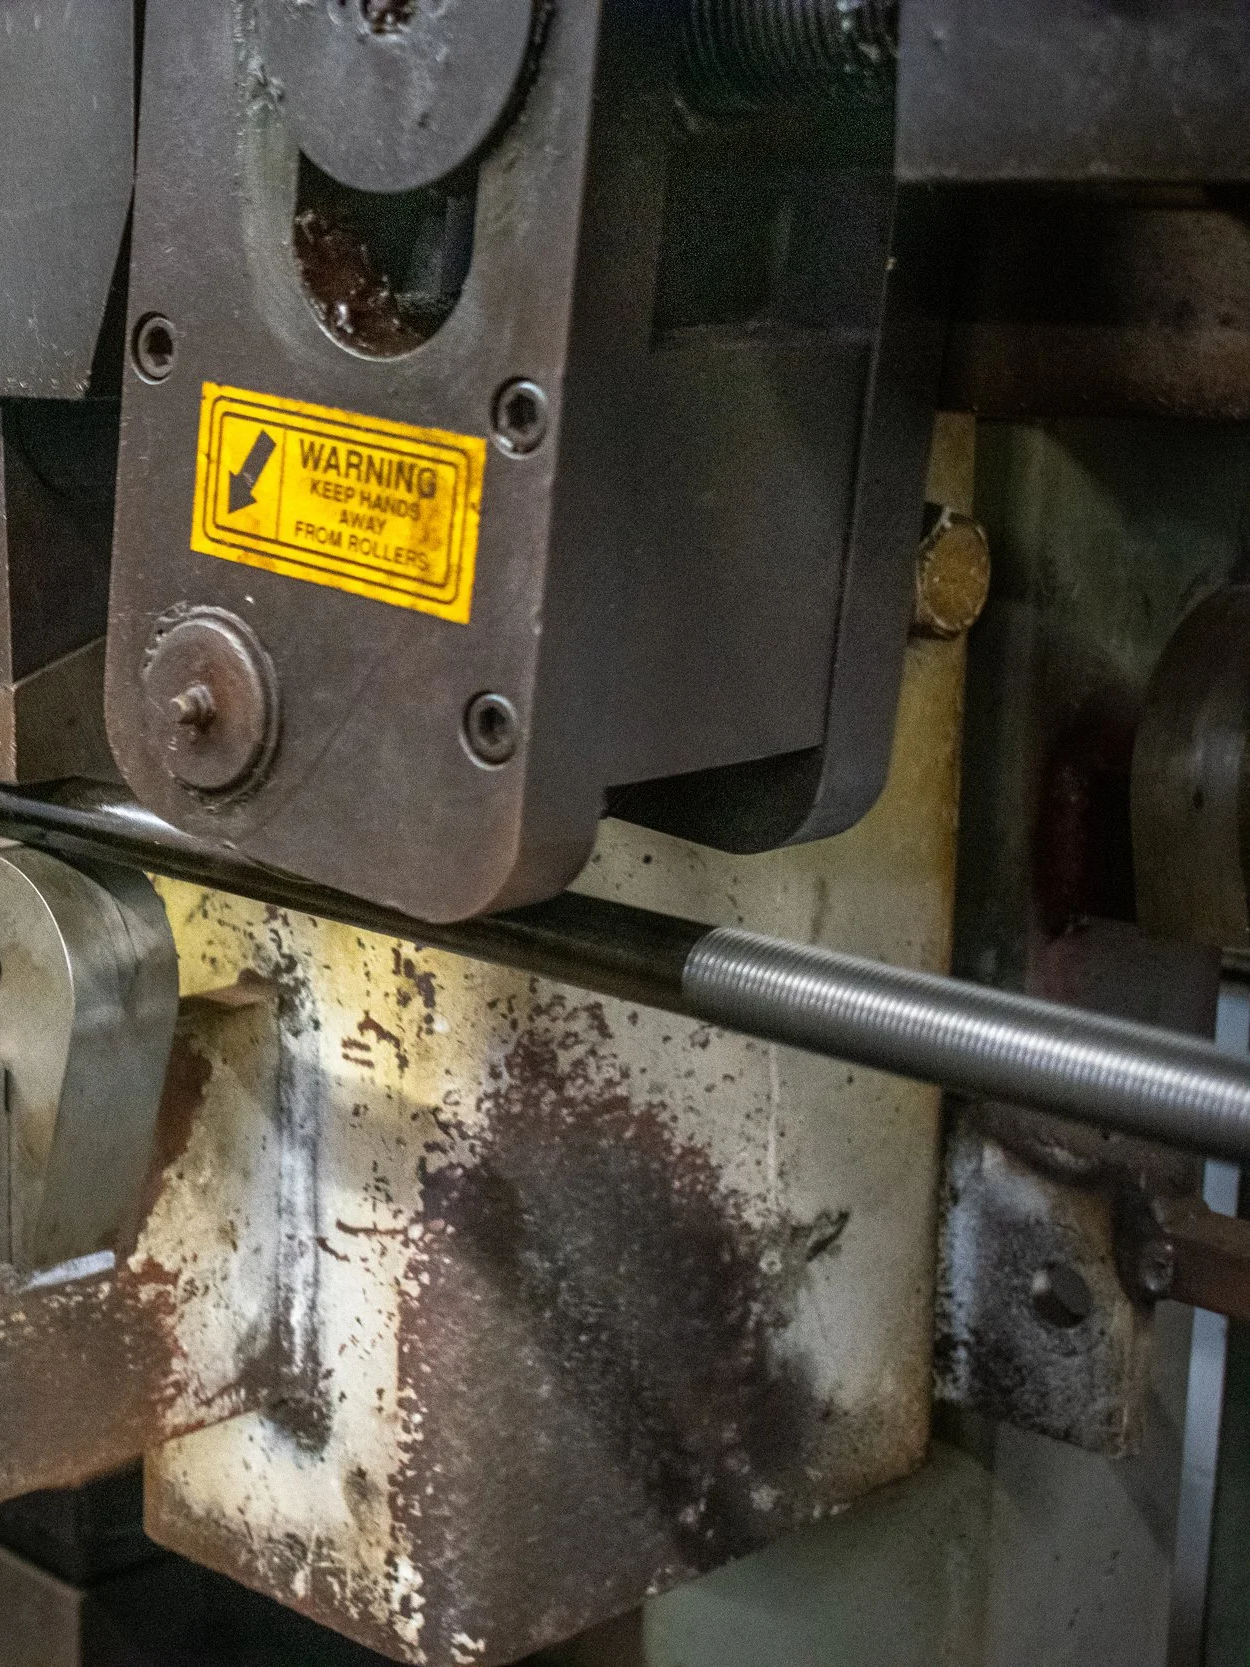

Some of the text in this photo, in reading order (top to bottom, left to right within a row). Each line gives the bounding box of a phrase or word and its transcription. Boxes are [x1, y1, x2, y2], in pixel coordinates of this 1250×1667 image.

[299, 438, 437, 498] WARNING
[310, 479, 421, 521] KEEP HANDS
[339, 509, 387, 535] AWAY
[294, 520, 431, 572] FROM ROLLERS
